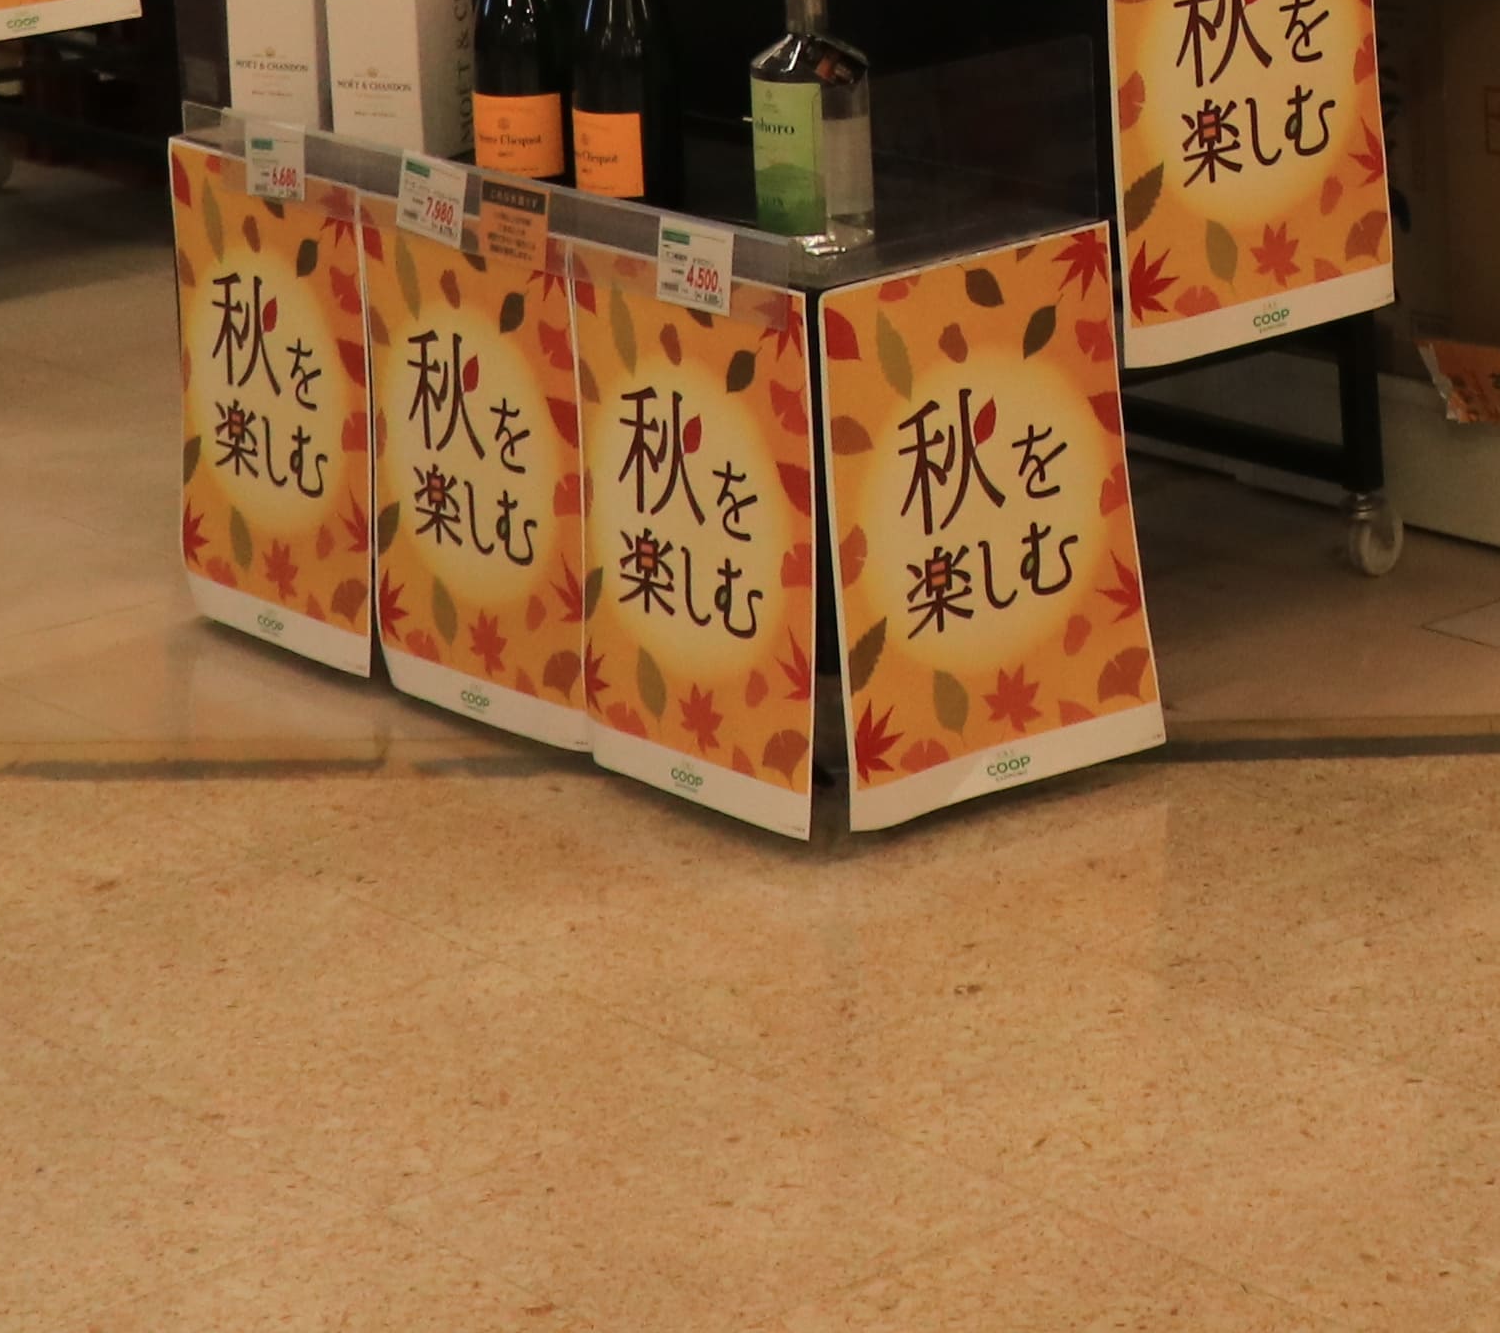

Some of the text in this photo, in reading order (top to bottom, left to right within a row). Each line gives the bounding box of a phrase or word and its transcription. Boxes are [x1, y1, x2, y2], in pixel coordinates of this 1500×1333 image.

[1180, 85, 1335, 188] 楽しむ
[210, 271, 322, 411] 秋を
[215, 397, 327, 498] 楽しむ
[407, 331, 530, 475] 秋を
[898, 388, 1068, 535] 秋を
[413, 462, 538, 568] 楽しむ
[618, 385, 757, 543] 秋を
[618, 527, 763, 640] 楽しむ
[905, 521, 1078, 638] 楽しむ
